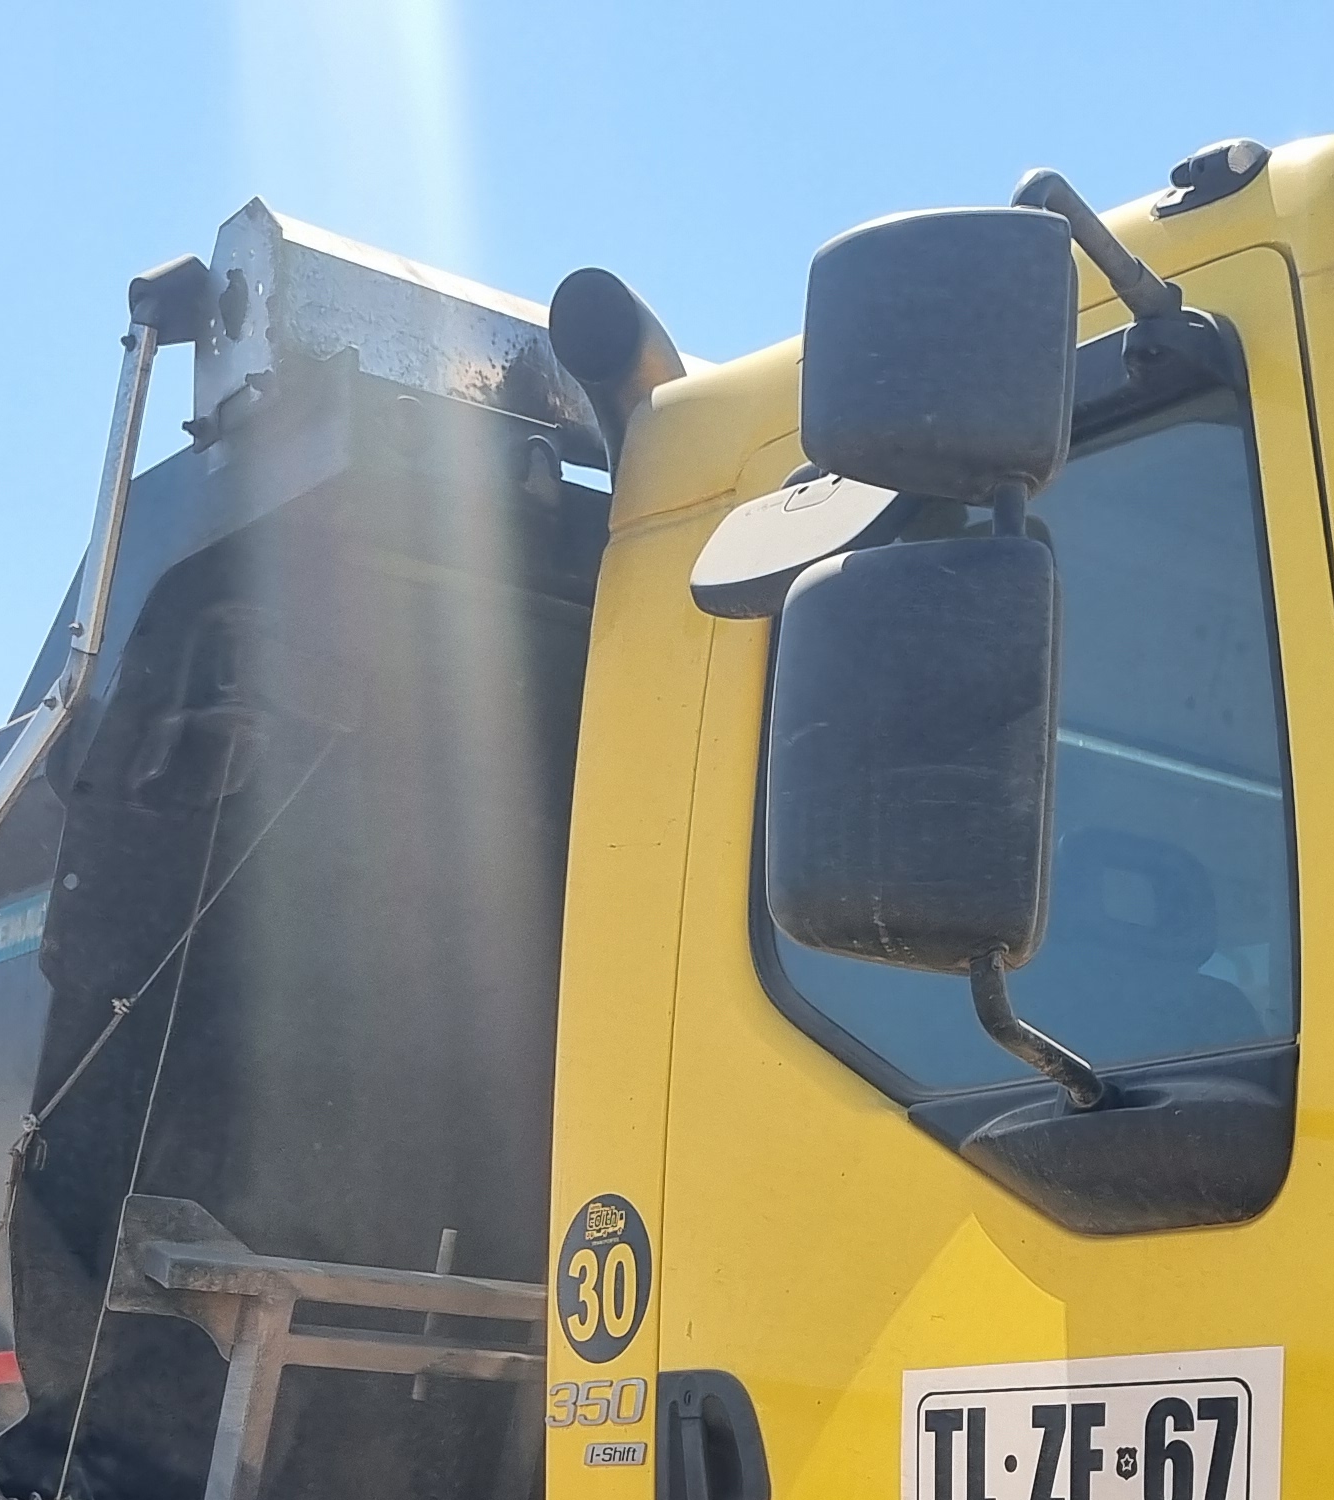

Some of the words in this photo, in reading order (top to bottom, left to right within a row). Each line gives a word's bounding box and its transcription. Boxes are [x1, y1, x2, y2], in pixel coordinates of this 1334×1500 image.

[567, 1243, 637, 1342] 30
[546, 1377, 648, 1428] 350
[590, 1445, 638, 1464] I-Shift
